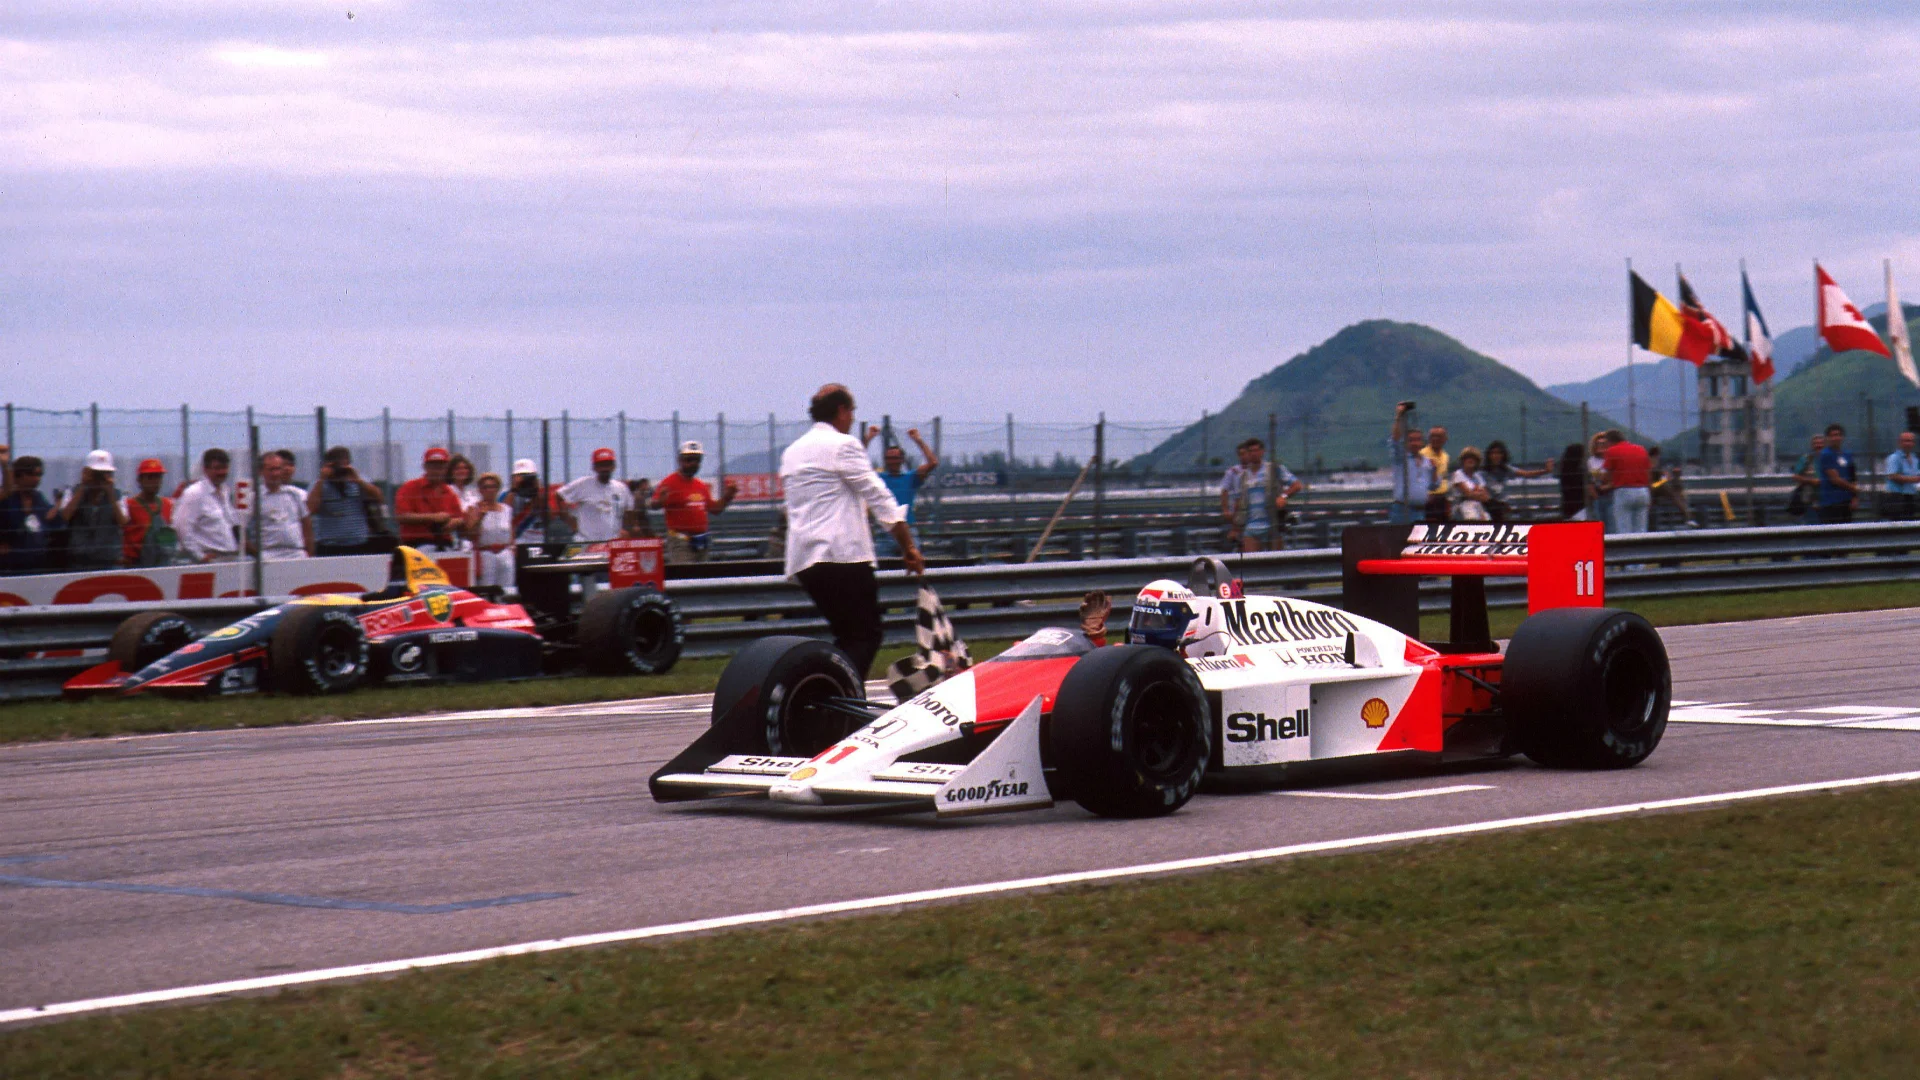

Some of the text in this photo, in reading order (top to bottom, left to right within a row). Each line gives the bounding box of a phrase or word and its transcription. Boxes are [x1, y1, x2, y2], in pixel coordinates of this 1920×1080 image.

[1574, 561, 1594, 596] 11
[1133, 606, 1162, 615] ONDA
[1220, 600, 1359, 646] Marlboro
[1190, 657, 1240, 672] arlboro
[1301, 652, 1346, 665] HON
[1227, 709, 1309, 743] Shell
[945, 780, 1028, 802] GOODYEAR
